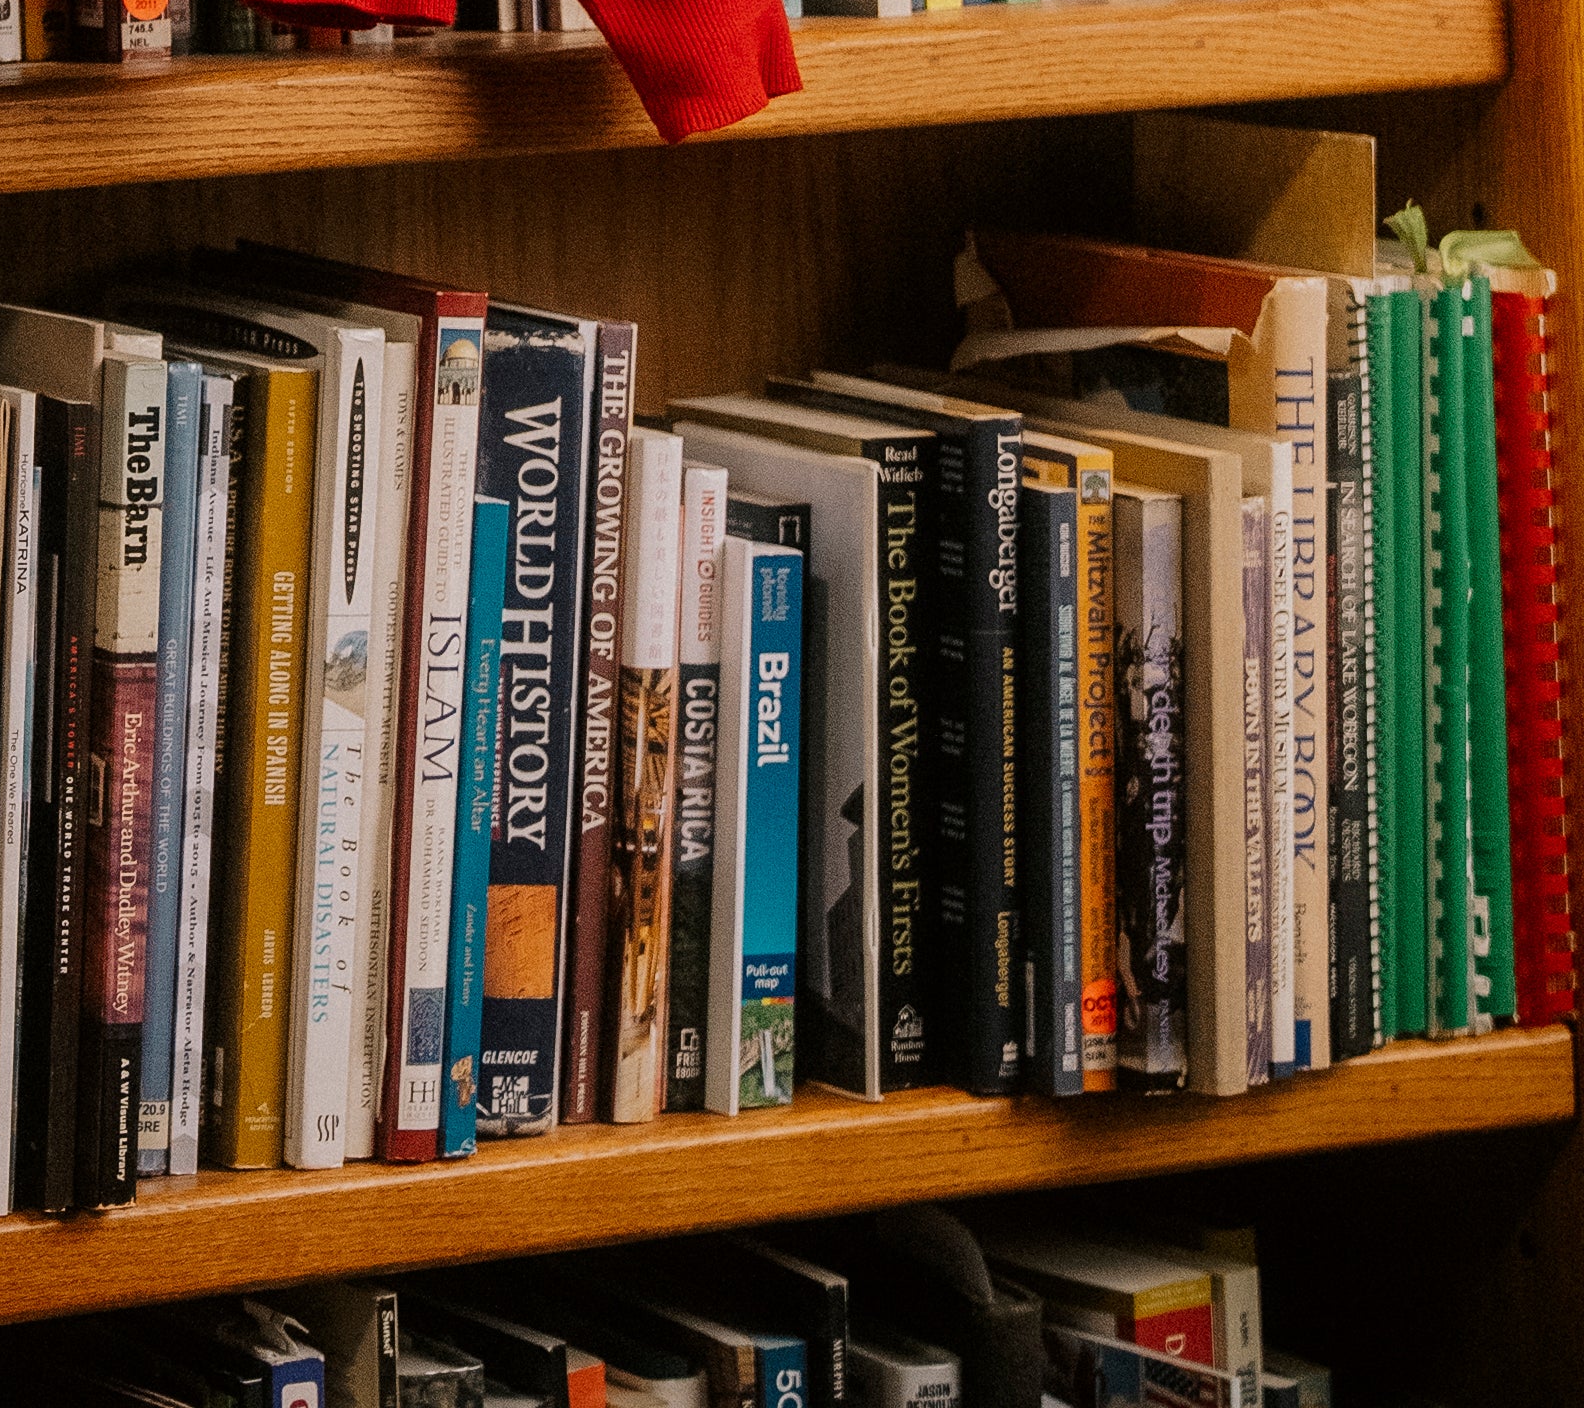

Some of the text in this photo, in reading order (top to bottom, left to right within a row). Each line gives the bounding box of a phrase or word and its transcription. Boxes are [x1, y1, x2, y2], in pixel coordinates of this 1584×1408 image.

[124, 406, 160, 566] The Barn
[988, 435, 1022, 614] Longaberger
[580, 350, 629, 834] THE GROWING OF AMERICA
[264, 571, 295, 805] GETTING ALONG IN SPANISH
[421, 612, 462, 785] ISLAM
[679, 678, 715, 862] COSTA RICA
[756, 651, 789, 766] Brazil
[887, 492, 921, 975] The Book of Women's Firsts
[113, 711, 143, 1015] Eric Arthur and Dudley Witney
